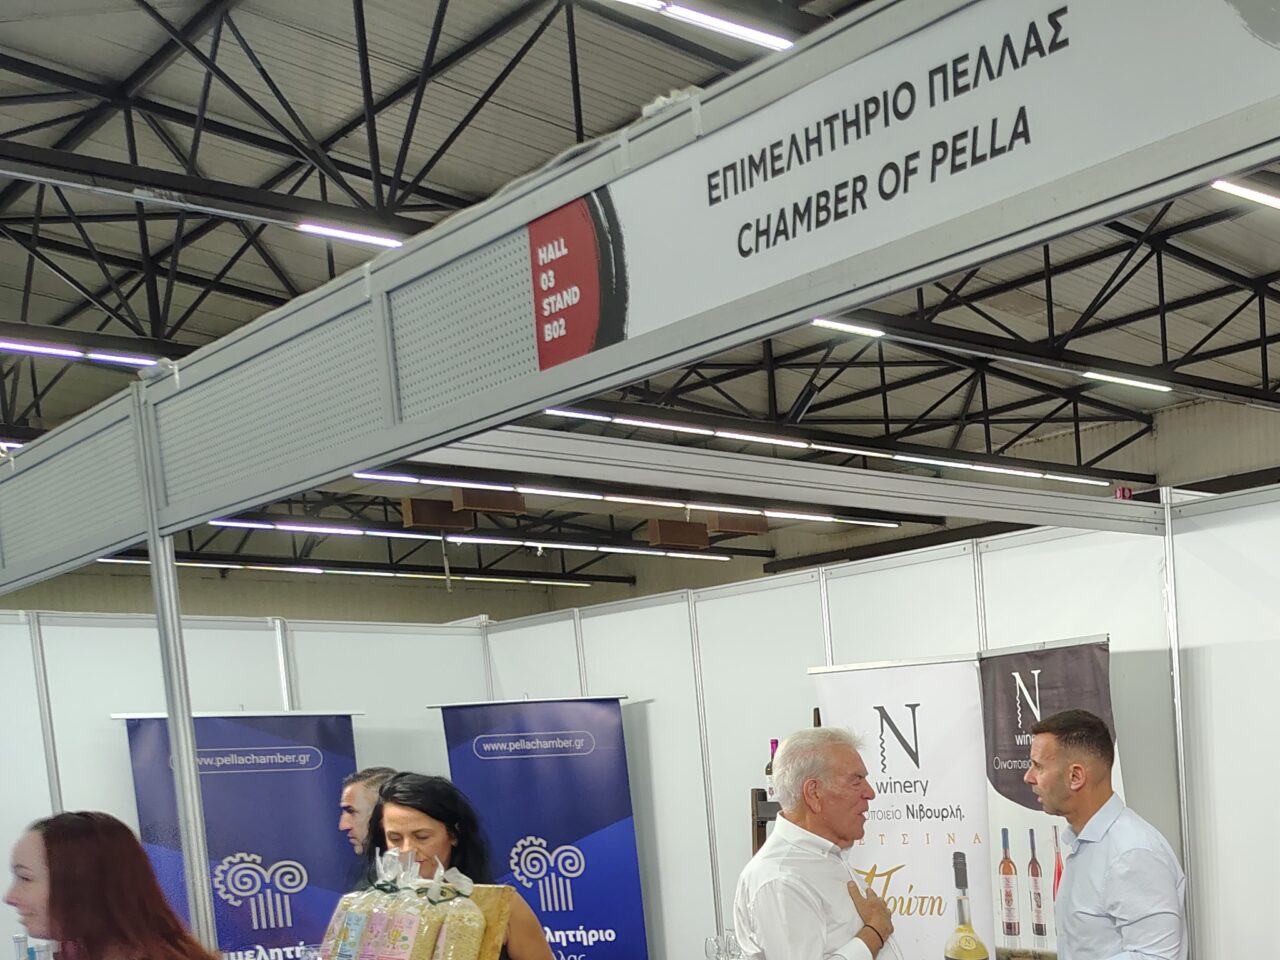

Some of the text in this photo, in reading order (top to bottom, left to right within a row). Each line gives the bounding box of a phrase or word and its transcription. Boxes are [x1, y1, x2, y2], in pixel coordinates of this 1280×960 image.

[707, 5, 1070, 207] ΕΠΙΜΕΛΗΤΗΡΙΟ ΠΕΛΛΑΣ
[737, 106, 1031, 258] CHAMBER OF PELLA
[538, 237, 568, 266] HALL
[540, 269, 555, 291] 03
[543, 286, 580, 317] STAND
[544, 318, 566, 342] B02
[482, 738, 584, 753] www.pellachamber.gr
[1015, 731, 1035, 746] win
[876, 777, 929, 797] winery
[858, 832, 982, 846] ΕΤΣΙΝΑ
[545, 926, 616, 946] λητήριο
